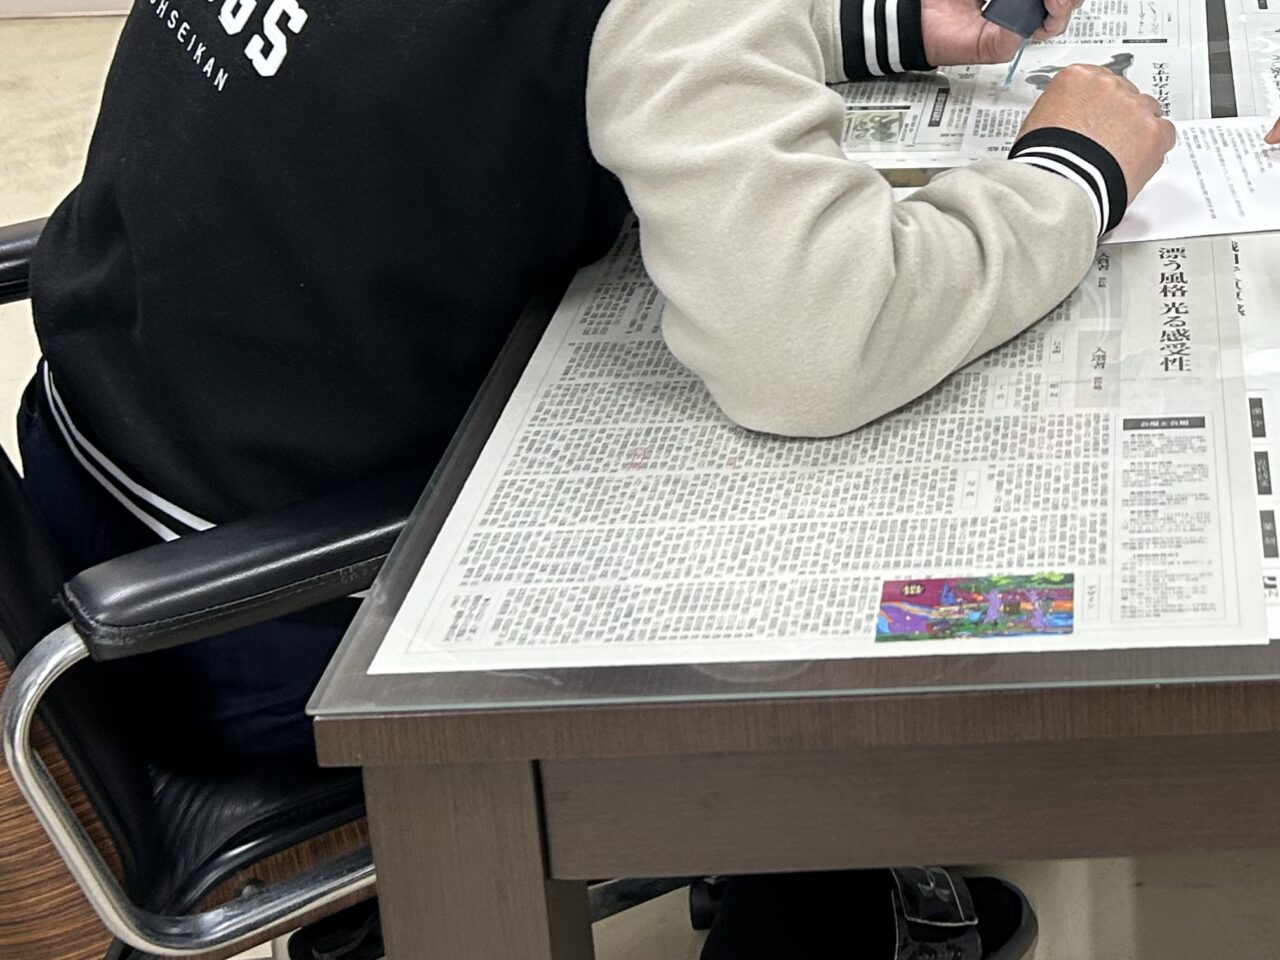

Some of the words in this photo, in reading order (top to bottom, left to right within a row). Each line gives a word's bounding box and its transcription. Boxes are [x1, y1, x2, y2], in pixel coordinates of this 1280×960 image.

[1158, 246, 1188, 298] 漂う風格
[1160, 302, 1192, 373] 光る感受性
